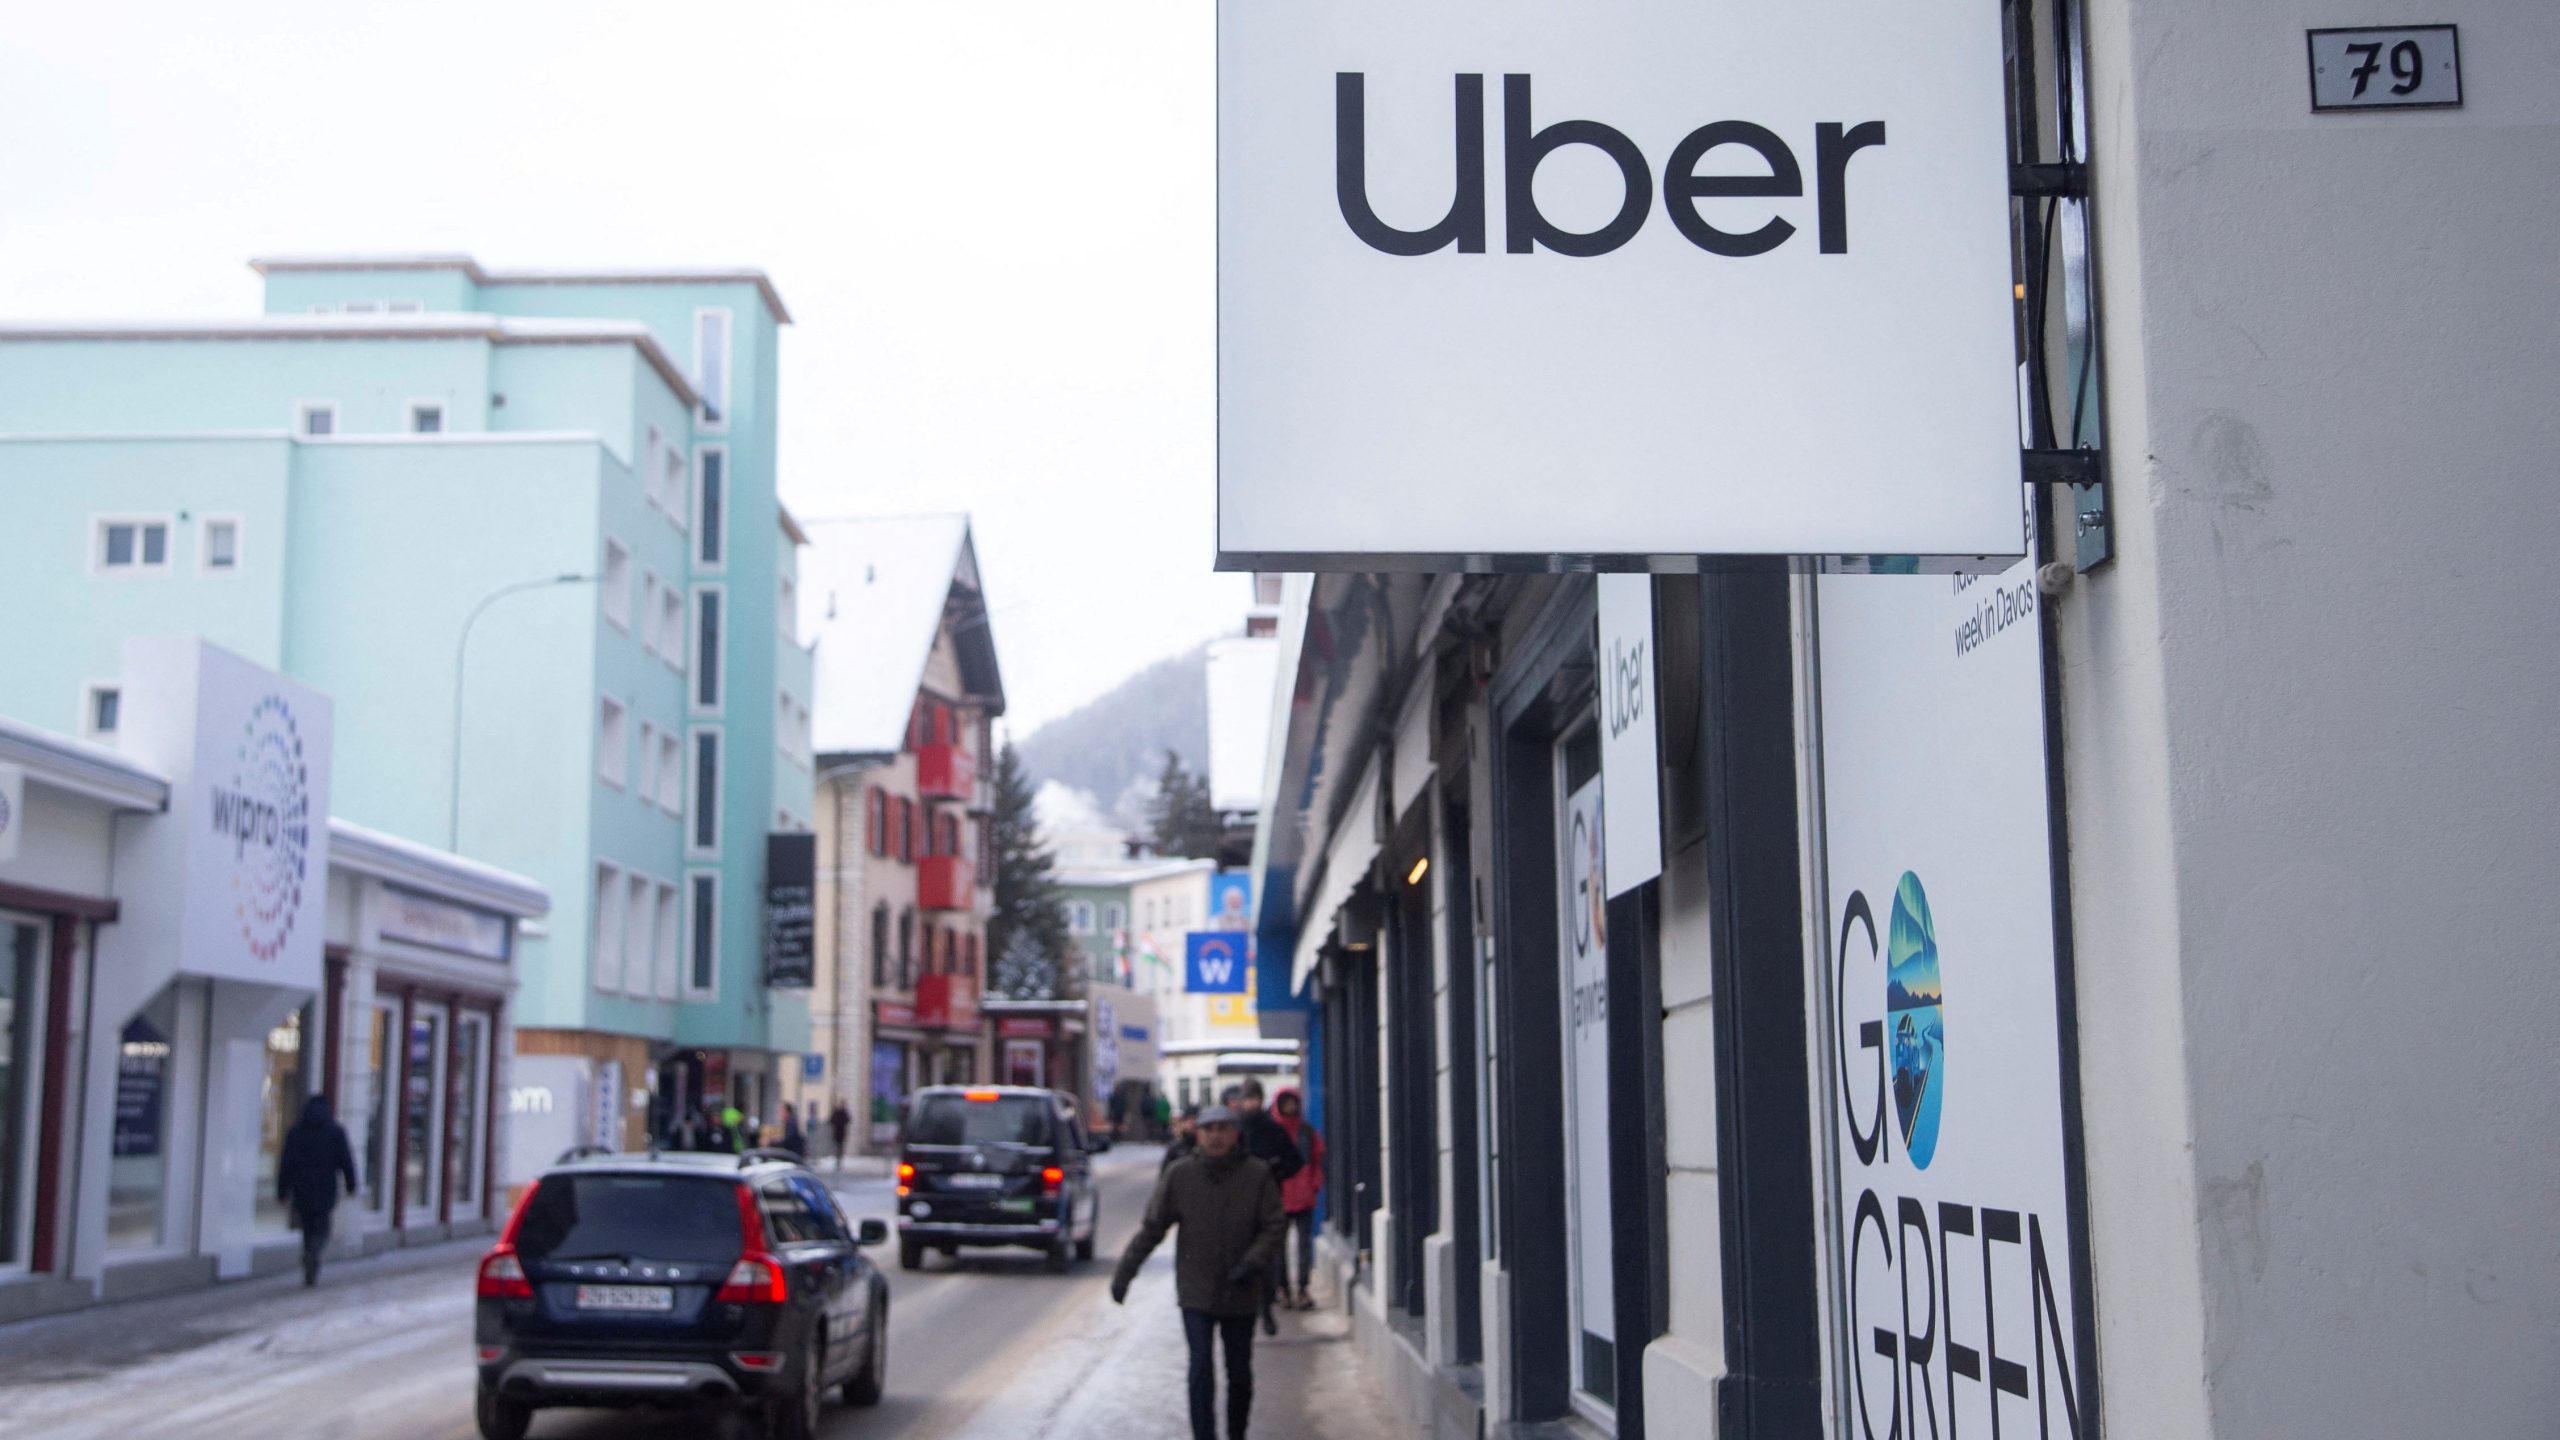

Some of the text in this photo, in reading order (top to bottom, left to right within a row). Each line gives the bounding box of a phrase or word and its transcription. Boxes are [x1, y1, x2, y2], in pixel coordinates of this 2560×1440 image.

[2345, 40, 2423, 100] 79
[1336, 72, 1886, 257] Uber
[1955, 602, 1984, 658] week
[1984, 597, 1995, 640] in
[1996, 579, 2033, 632] Davos
[1608, 638, 1644, 739] Uber
[211, 774, 279, 860] wipro
[1850, 1188, 2079, 1440] GREEN
